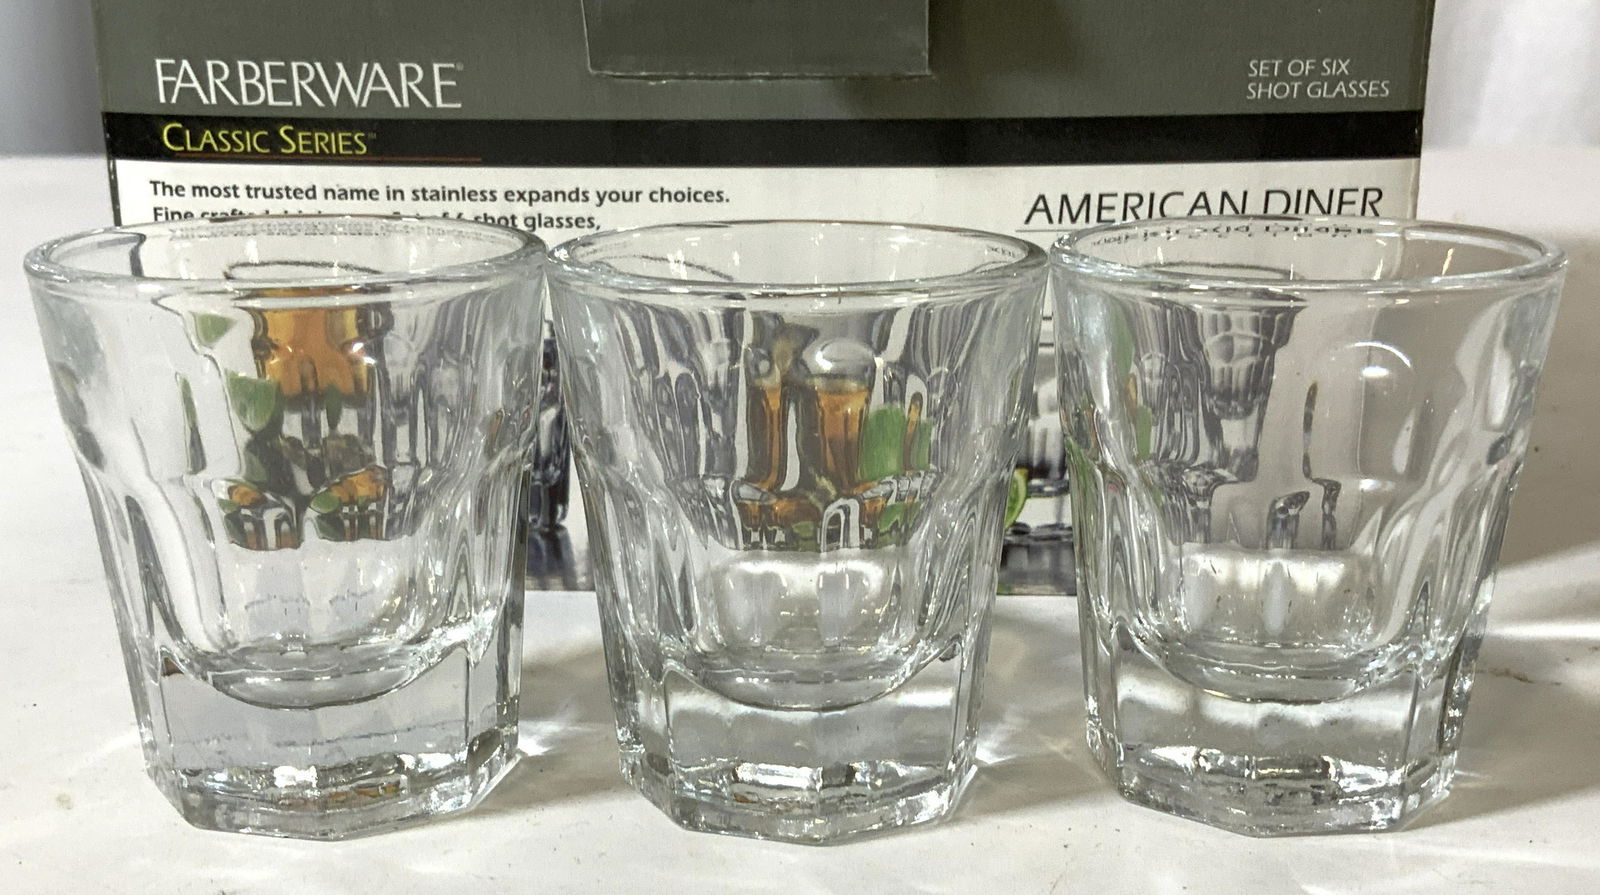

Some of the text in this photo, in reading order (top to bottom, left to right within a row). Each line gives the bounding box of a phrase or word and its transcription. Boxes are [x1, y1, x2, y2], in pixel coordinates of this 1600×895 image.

[1248, 59, 1351, 77] SET OF SIX
[155, 59, 462, 108] FARBERWARE
[1246, 81, 1390, 100] SHOT GLASSES
[162, 122, 271, 153] CLASSIC
[150, 181, 731, 207] The most trusted name in stainless expands your choices.
[1024, 188, 1384, 225] AMERICAN DINER
[523, 213, 601, 231] glasses,
